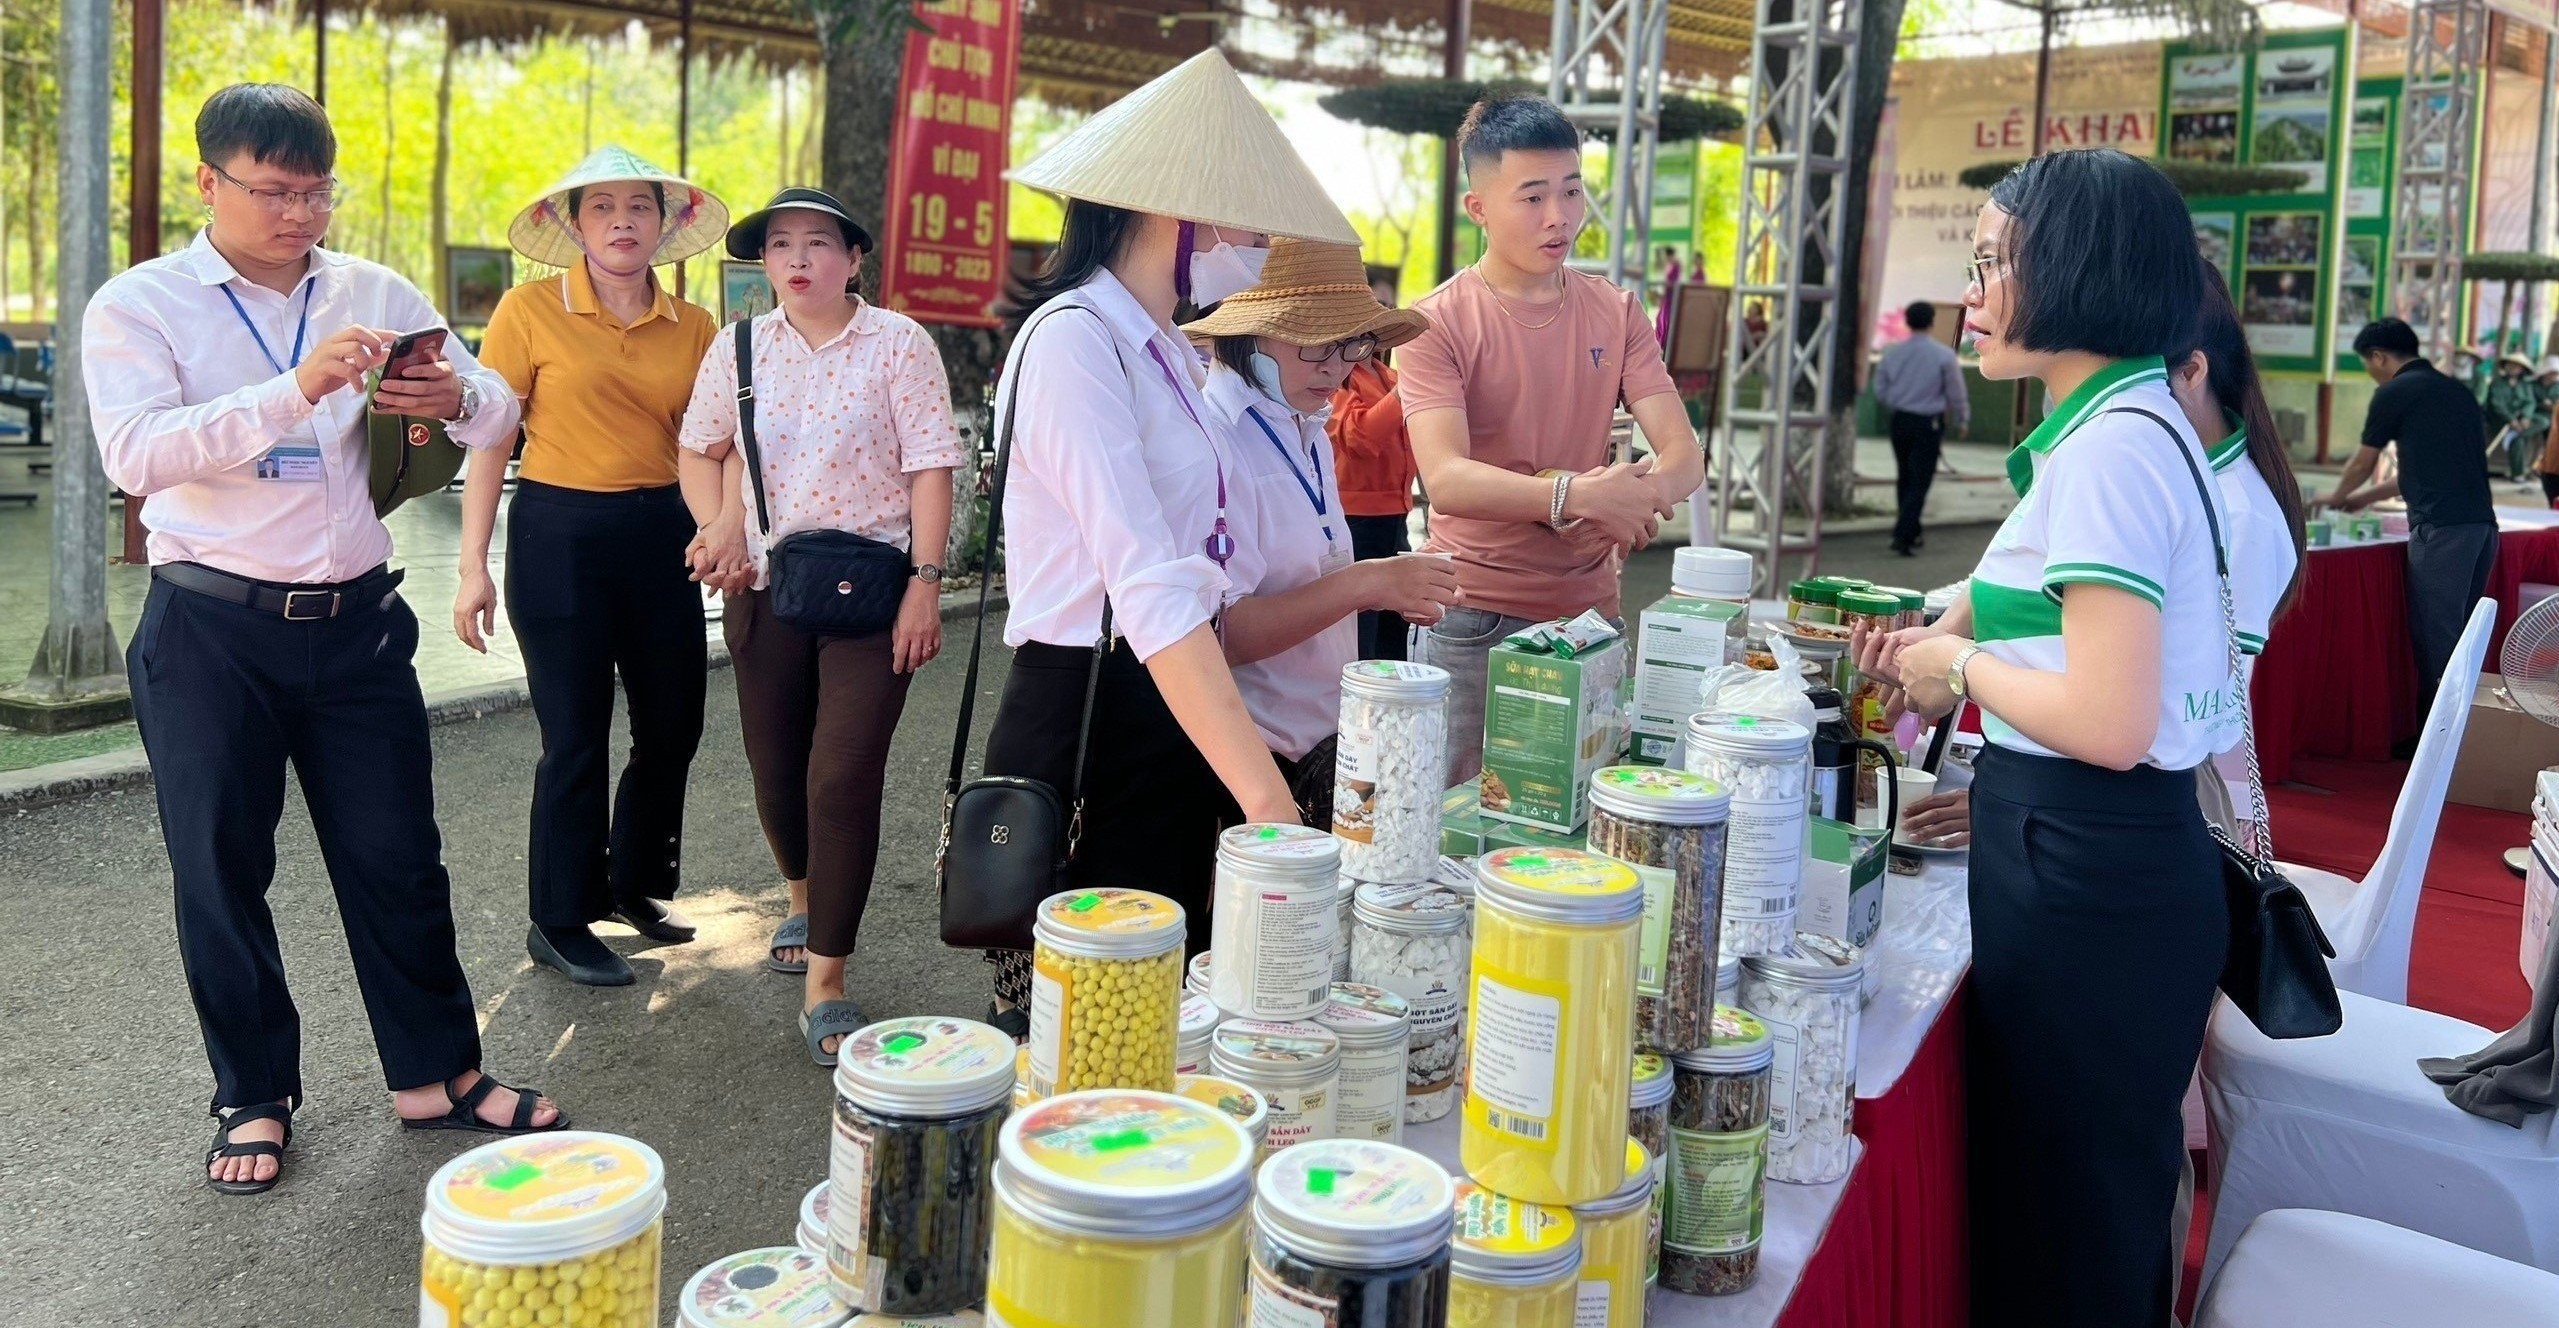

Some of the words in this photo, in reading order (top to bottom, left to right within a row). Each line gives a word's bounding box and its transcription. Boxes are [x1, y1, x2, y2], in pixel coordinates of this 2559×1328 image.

[910, 192, 947, 241] 19
[973, 200, 994, 246] 5
[954, 256, 992, 281] 2023
